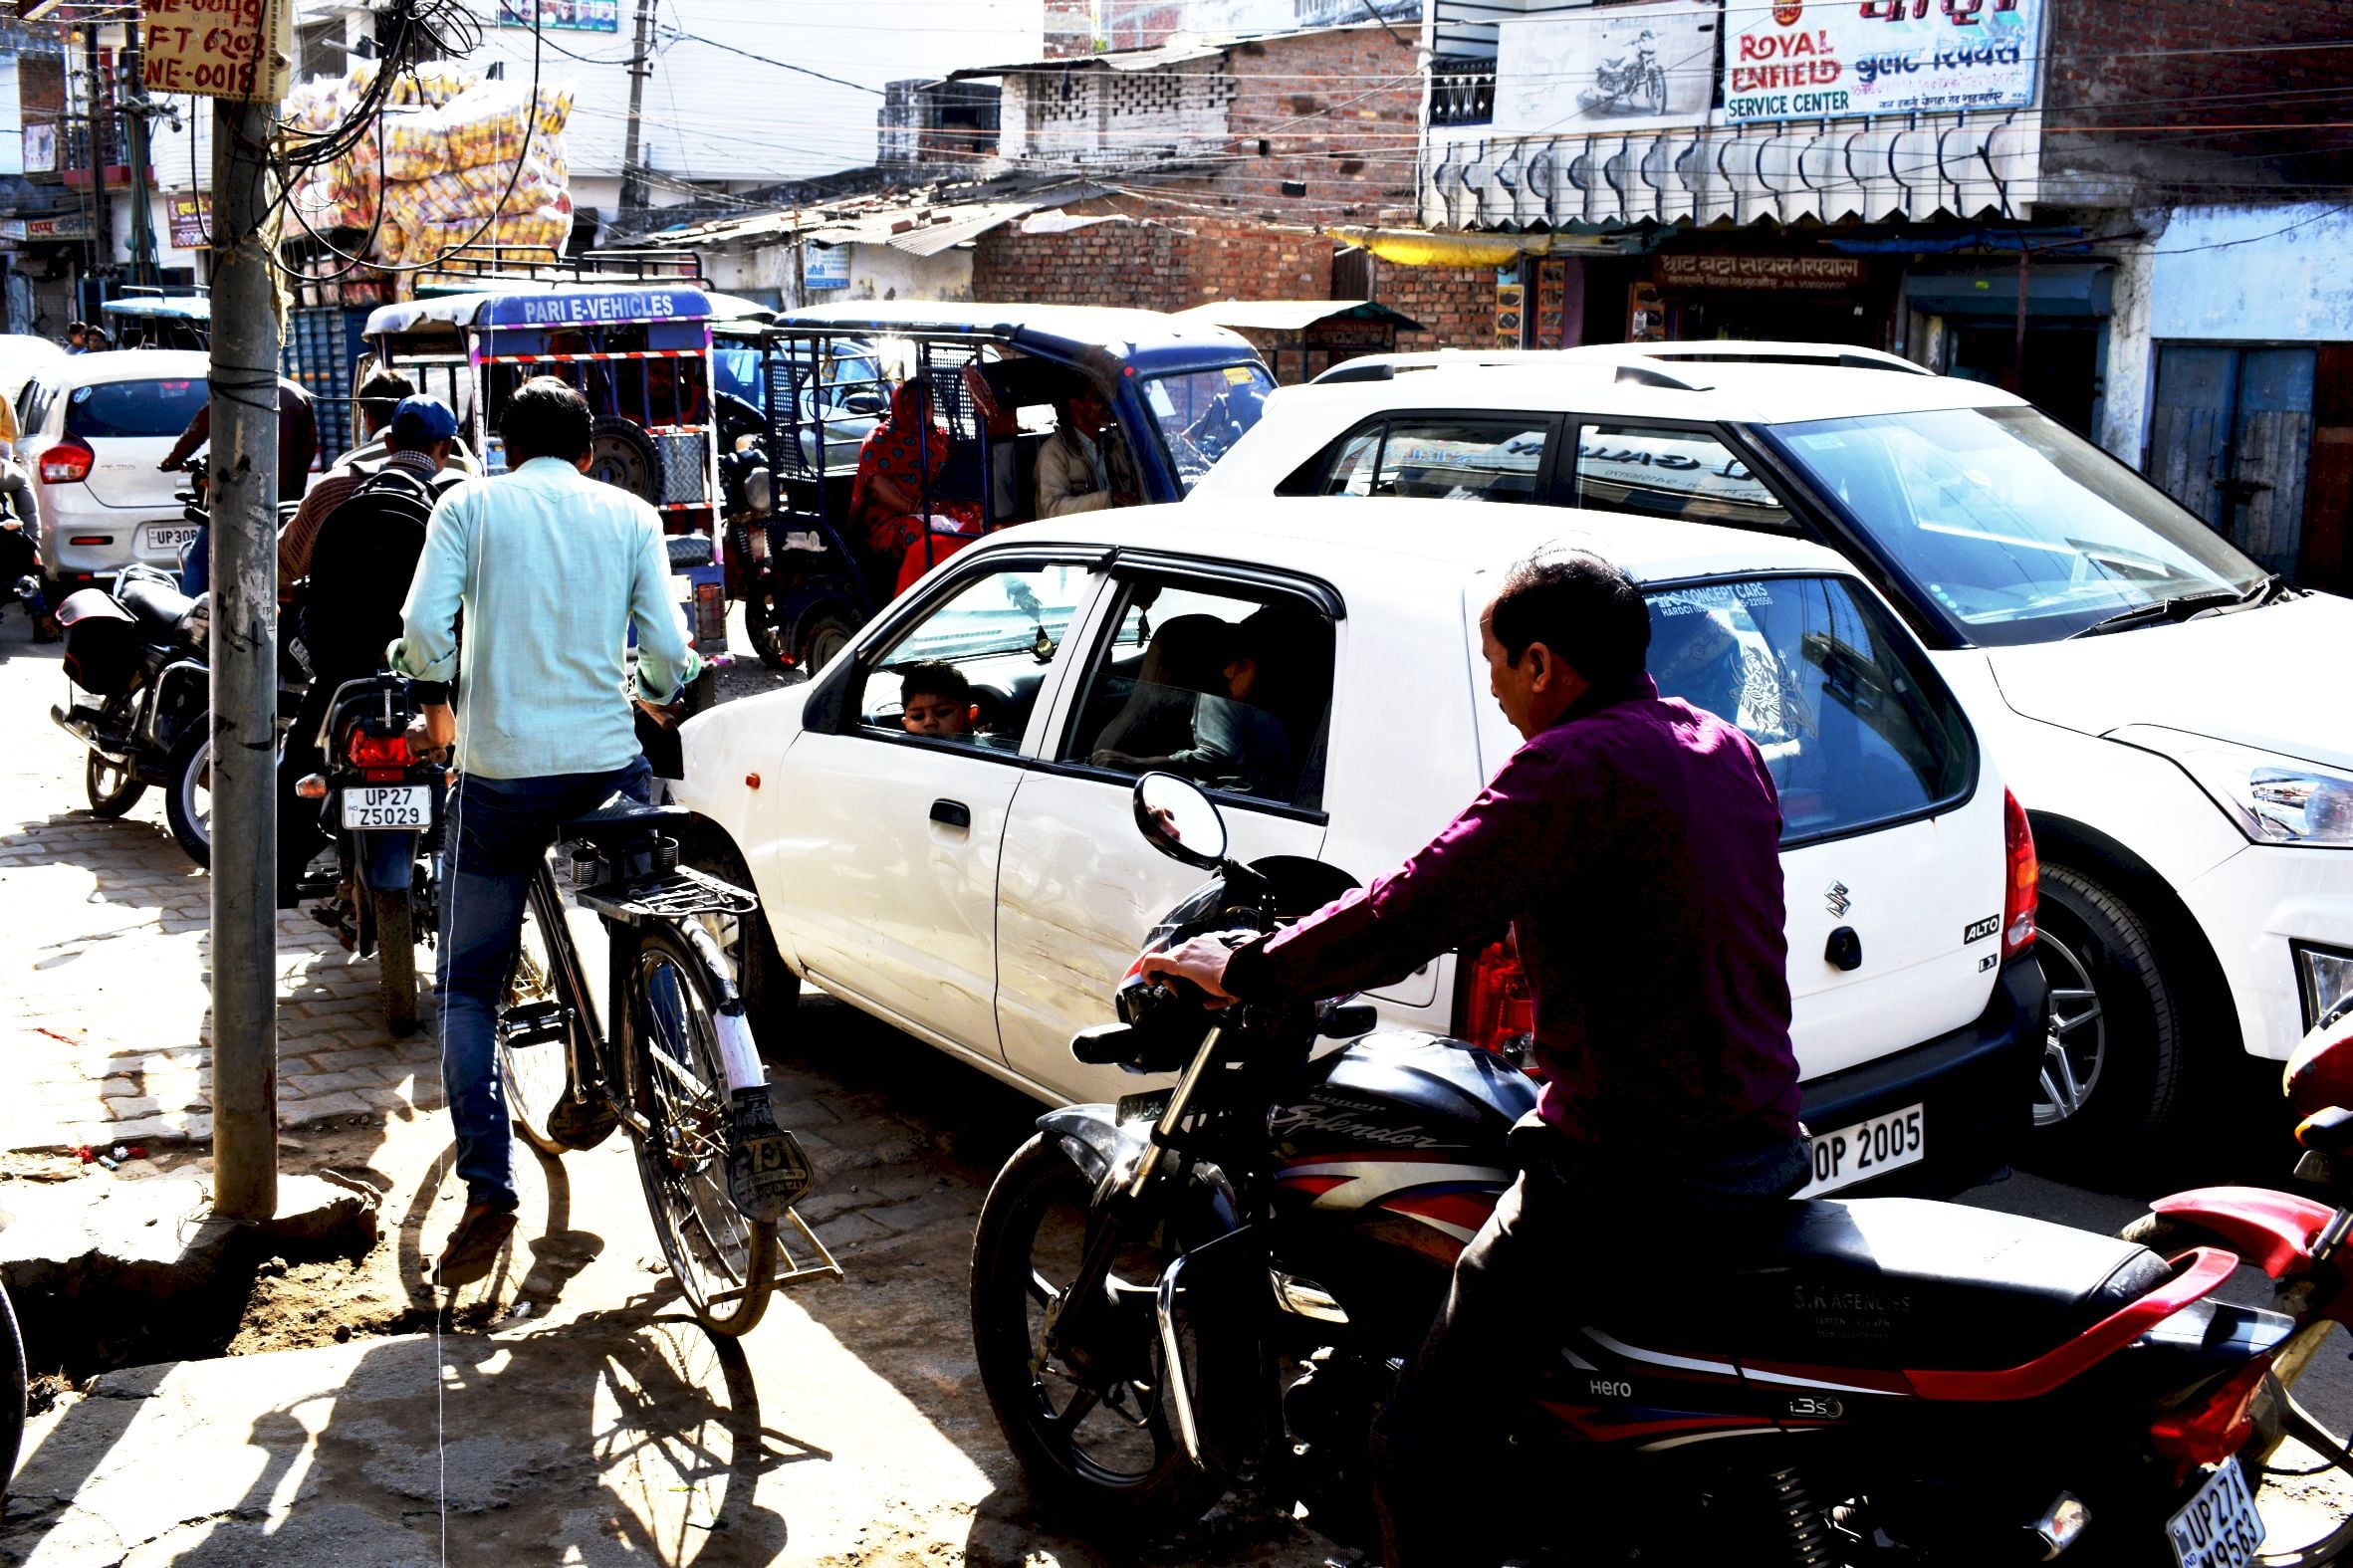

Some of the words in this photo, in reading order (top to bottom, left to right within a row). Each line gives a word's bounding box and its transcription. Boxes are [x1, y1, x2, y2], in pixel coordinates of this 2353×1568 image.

[148, 25, 192, 53] FT
[1740, 30, 1834, 62] ROYAL
[1733, 59, 1842, 93] ENFIELD
[1729, 95, 1788, 117] SERVICE
[1792, 91, 1849, 112] CENTER
[525, 302, 566, 323] PARI
[571, 295, 674, 321] E-VEHICLES
[1682, 585, 1735, 603] CONCEPT
[1735, 581, 1767, 598] CARS
[365, 788, 412, 806] UP27
[359, 807, 420, 826] Z5029
[1966, 917, 1999, 942] ALTO
[1273, 1104, 1471, 1148] Splendor
[1857, 1111, 1921, 1170] 2005
[1589, 1380, 1632, 1397] Hero
